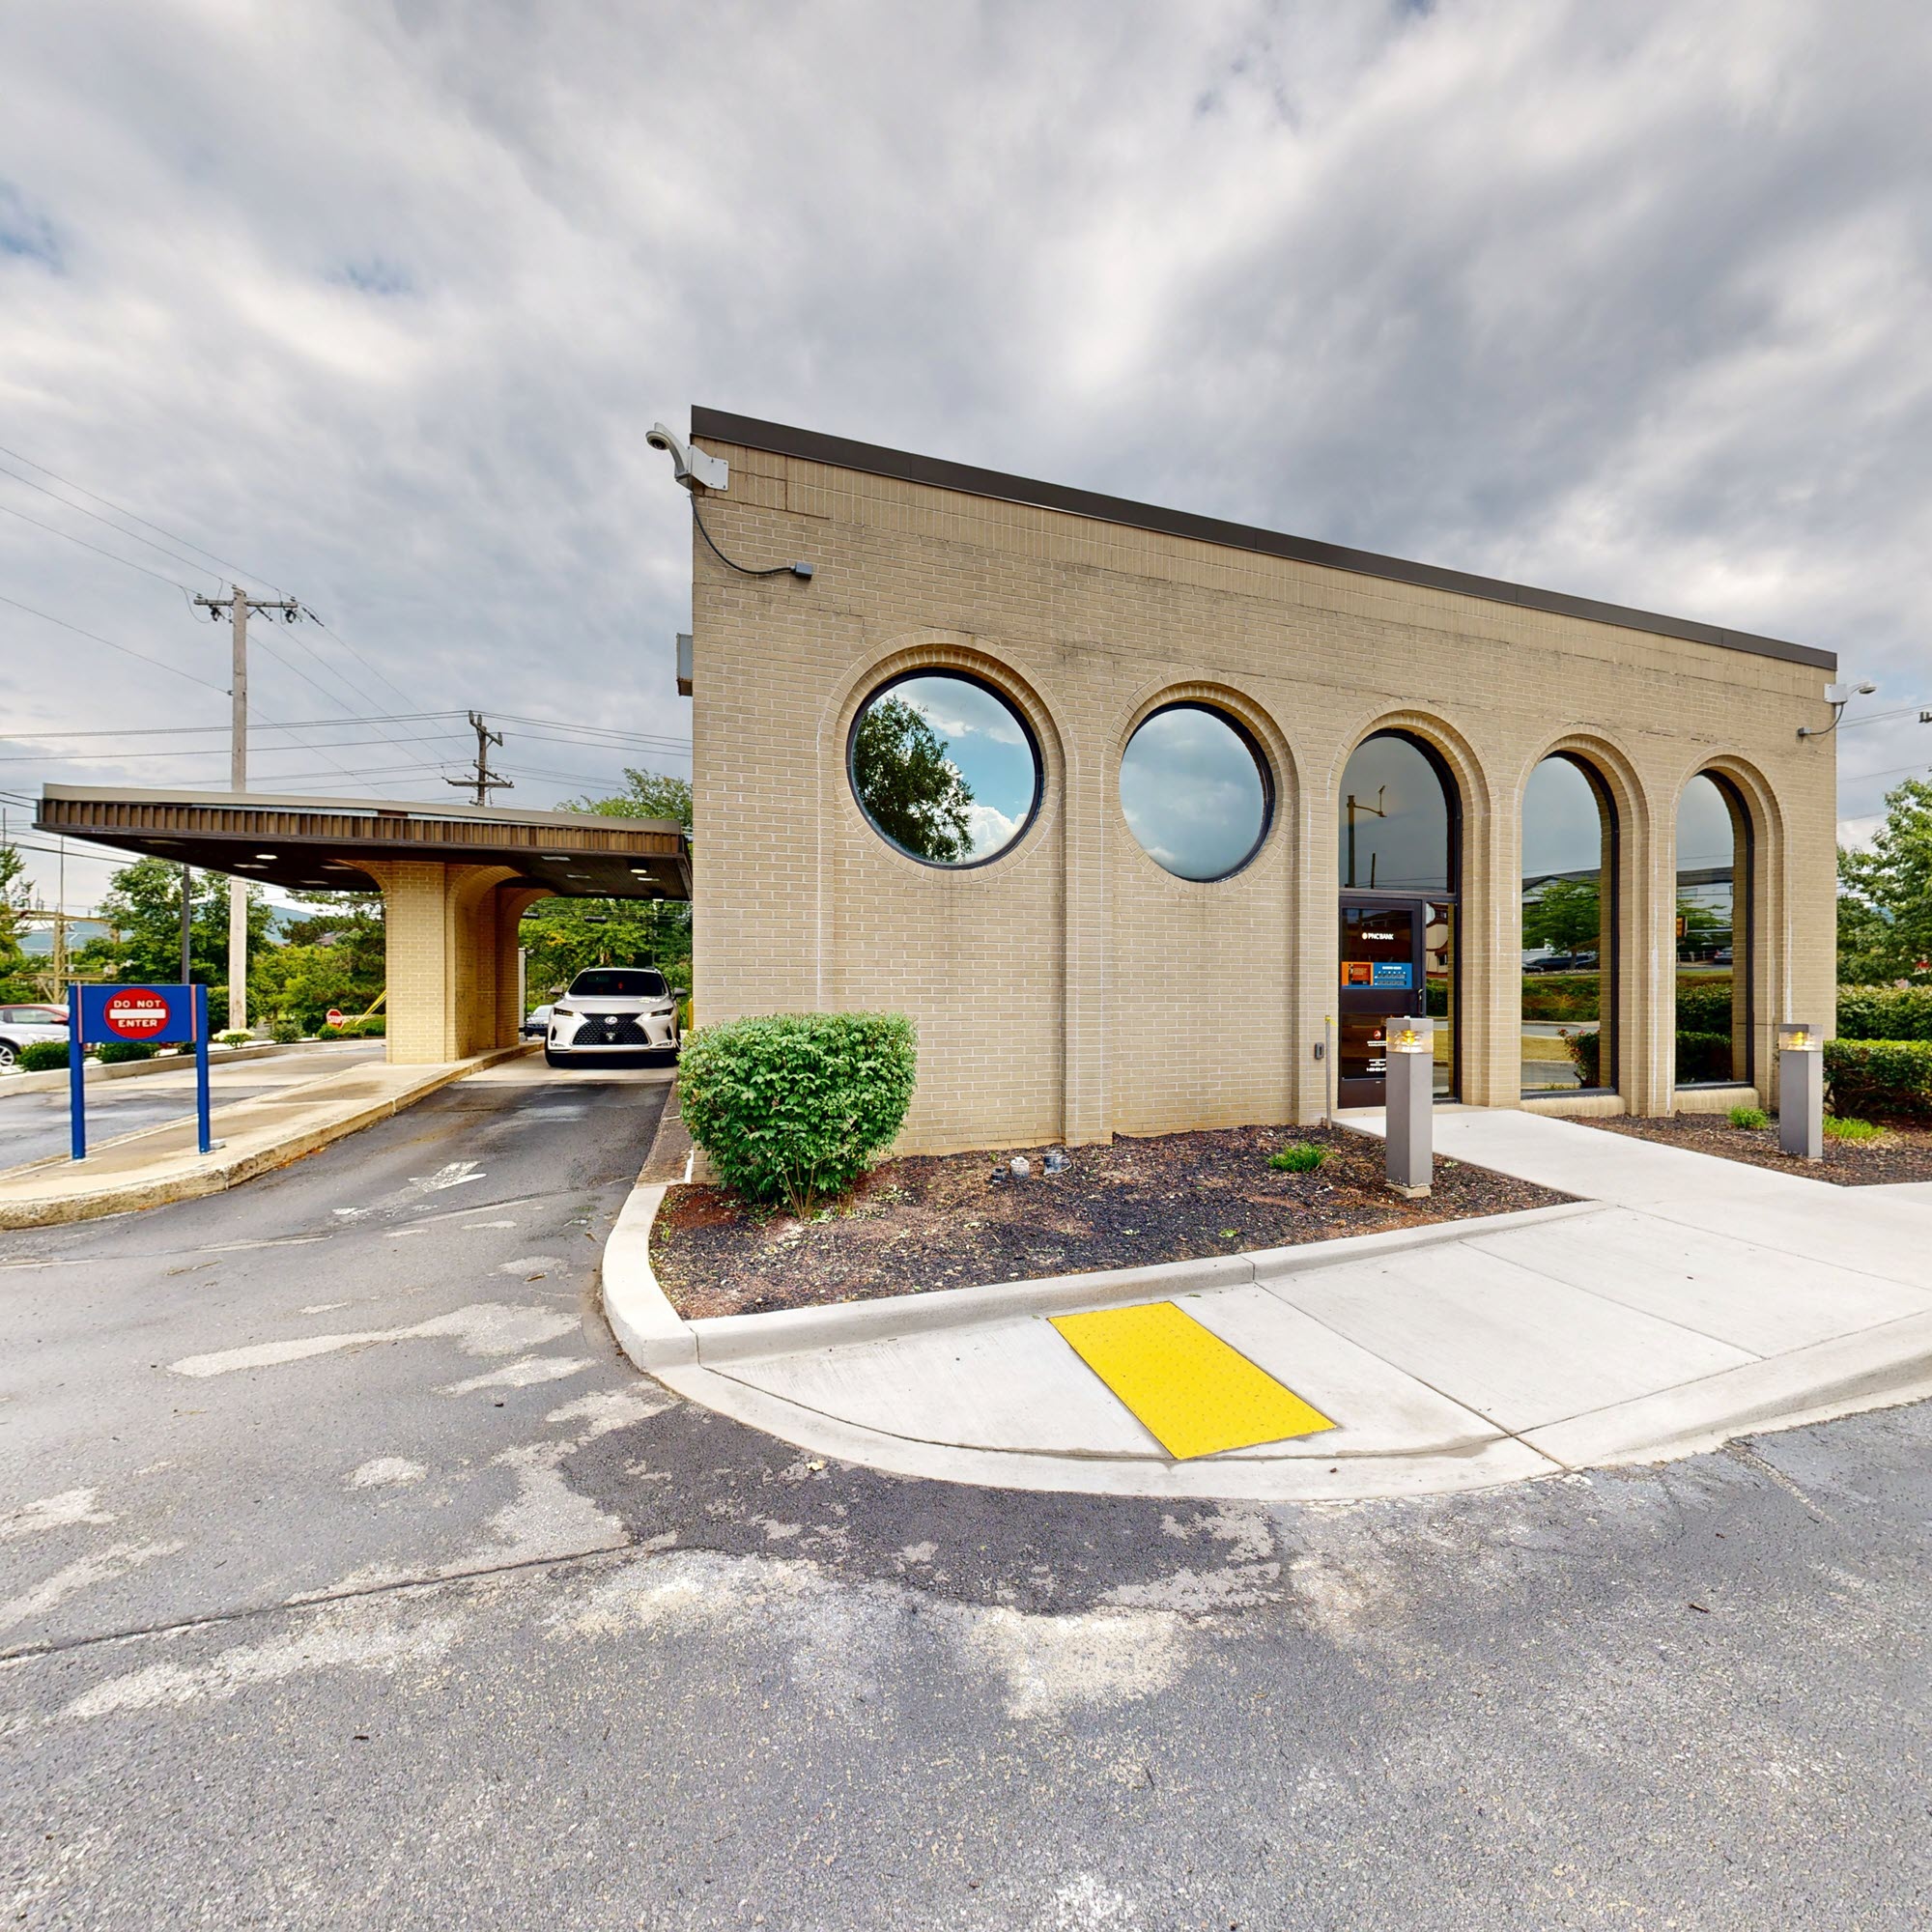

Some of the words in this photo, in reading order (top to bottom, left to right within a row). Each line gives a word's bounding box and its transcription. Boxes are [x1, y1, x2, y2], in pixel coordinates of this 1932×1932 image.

[113, 1000, 130, 1009] DO
[136, 1000, 161, 1009] NOT
[118, 1019, 157, 1028] ENTER
